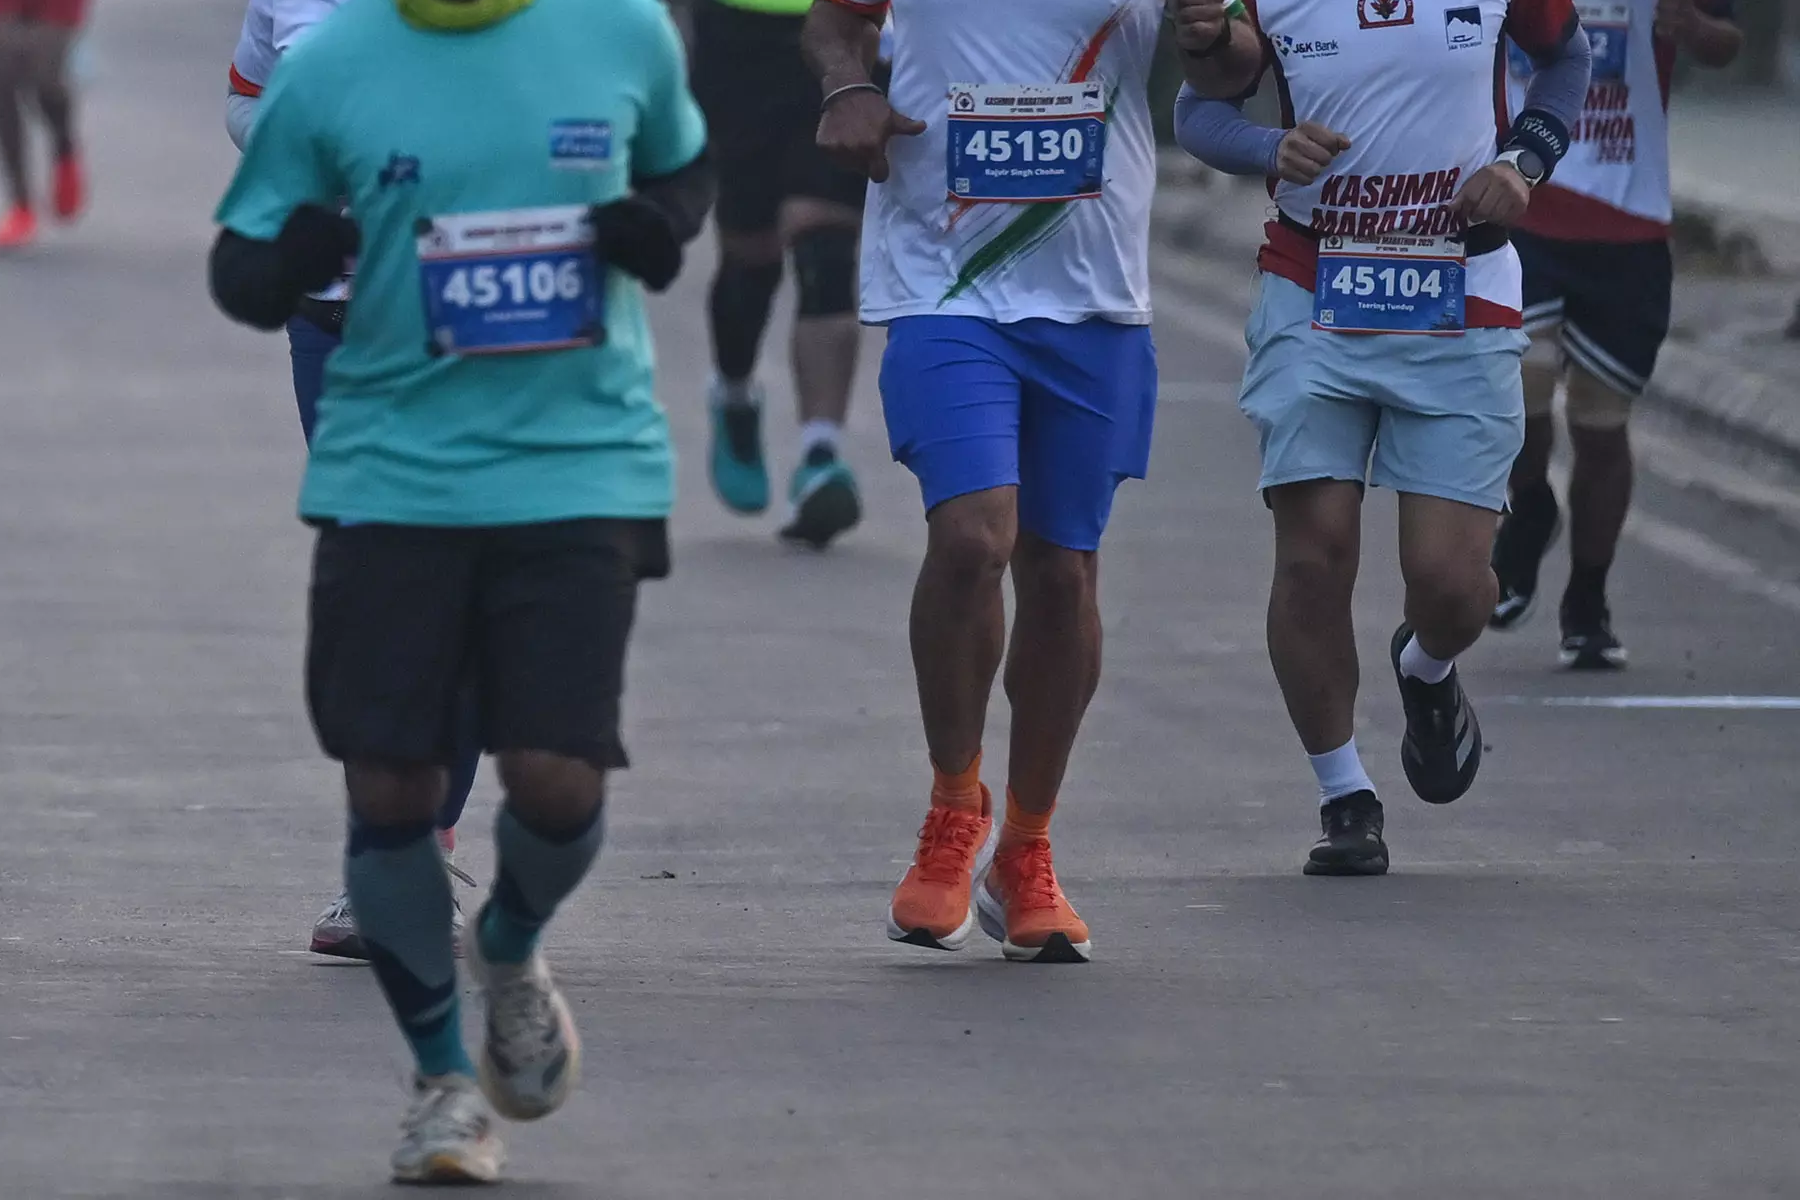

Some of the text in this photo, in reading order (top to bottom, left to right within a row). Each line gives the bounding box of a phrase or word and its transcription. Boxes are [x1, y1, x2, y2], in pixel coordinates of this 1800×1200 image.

[1292, 39, 1339, 54] J&K Bank
[964, 128, 1083, 162] 45130
[1010, 168, 1033, 178] Singh
[1319, 166, 1461, 209] KASHMIR
[443, 257, 583, 309] 45106
[1331, 265, 1442, 298] 45104
[1387, 302, 1414, 312] Tundup
